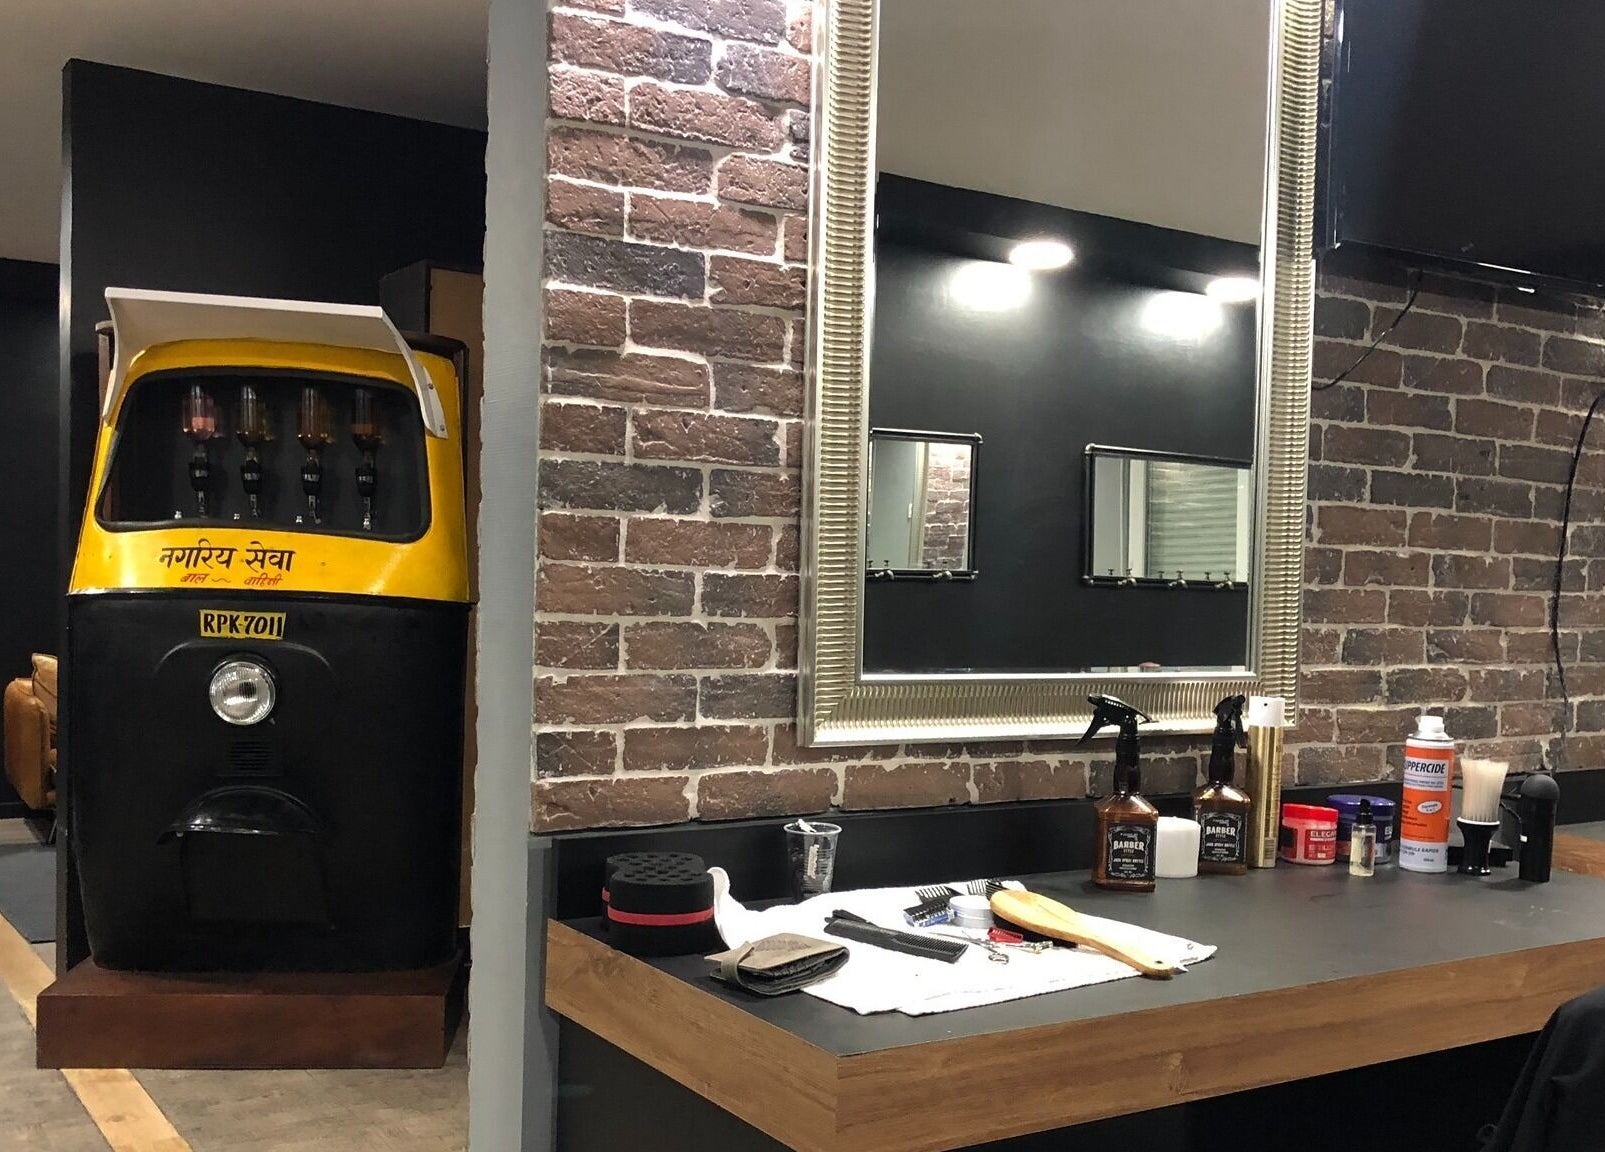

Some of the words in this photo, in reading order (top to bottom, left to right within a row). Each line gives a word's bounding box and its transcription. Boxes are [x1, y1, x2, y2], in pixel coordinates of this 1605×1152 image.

[245, 541, 296, 572] सेवा
[1205, 826, 1236, 837] BARBER
[1113, 840, 1145, 851] BARBER
